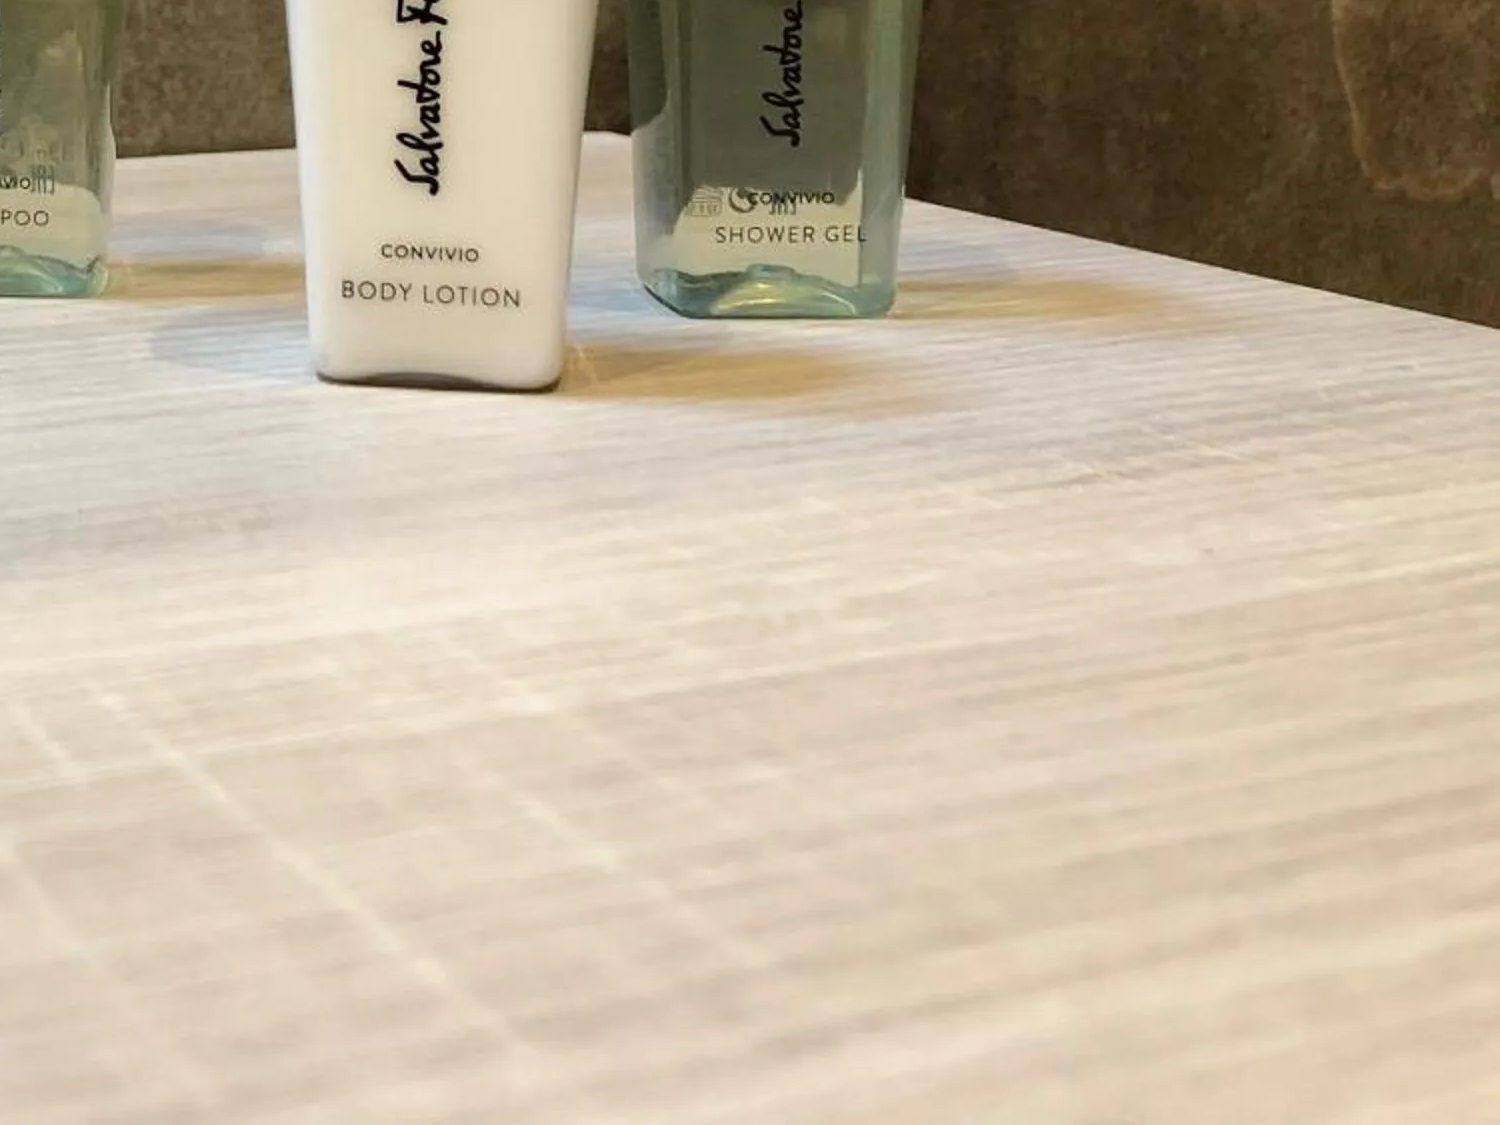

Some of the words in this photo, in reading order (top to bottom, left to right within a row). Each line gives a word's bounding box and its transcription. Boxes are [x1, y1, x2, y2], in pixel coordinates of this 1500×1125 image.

[759, 0, 805, 148] Salvatore
[393, 30, 443, 196] Salvatore
[750, 191, 836, 205] CONVIVIO
[714, 225, 816, 244] SHOWER
[824, 224, 868, 243] GEL
[380, 243, 480, 263] CONVIVIO
[340, 279, 413, 302] BODY
[423, 284, 521, 308] LOTION
